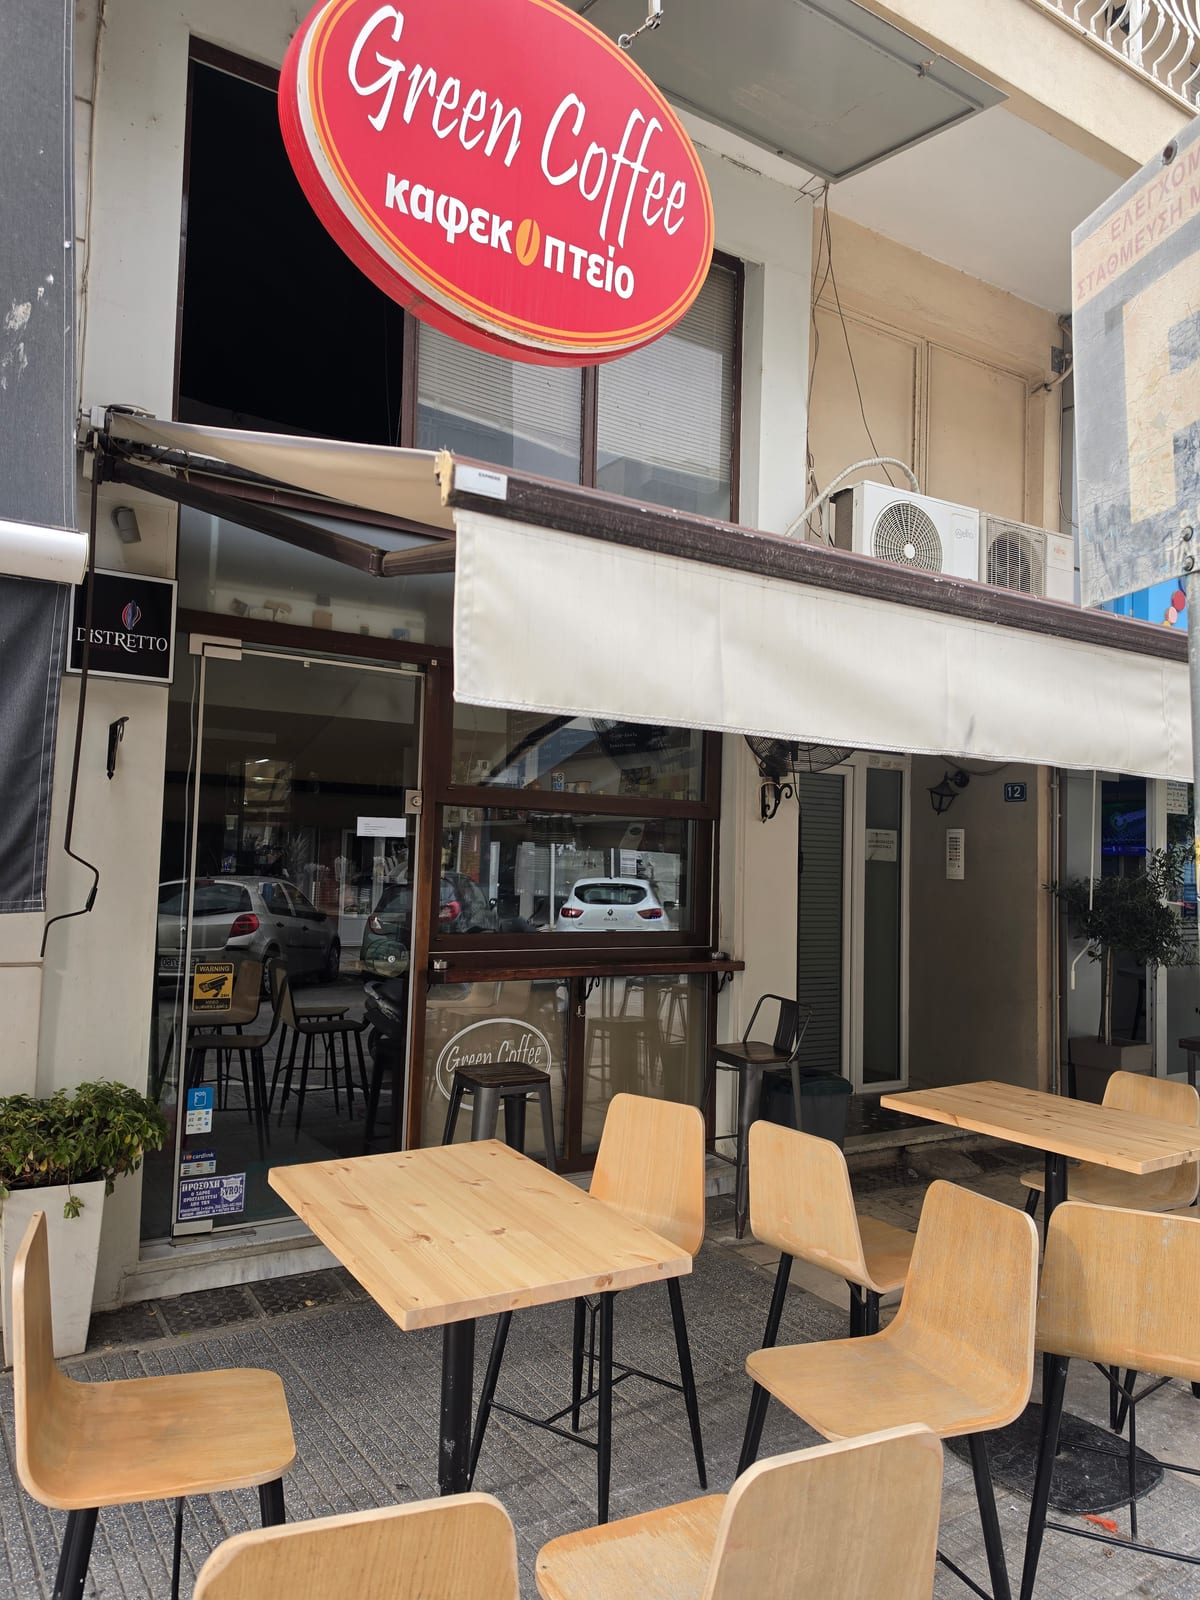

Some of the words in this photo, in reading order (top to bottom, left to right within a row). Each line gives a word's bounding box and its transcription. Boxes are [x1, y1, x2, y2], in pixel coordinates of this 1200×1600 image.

[347, 5, 522, 167] Green
[541, 93, 686, 248] Coffee
[1077, 197, 1182, 300] ΣΤΑΘΜΕΥΣΗ
[1008, 786, 1021, 797] 12
[193, 1151, 214, 1160] cardlink
[182, 1180, 220, 1192] ΠΡΟΣΟΧΗ
